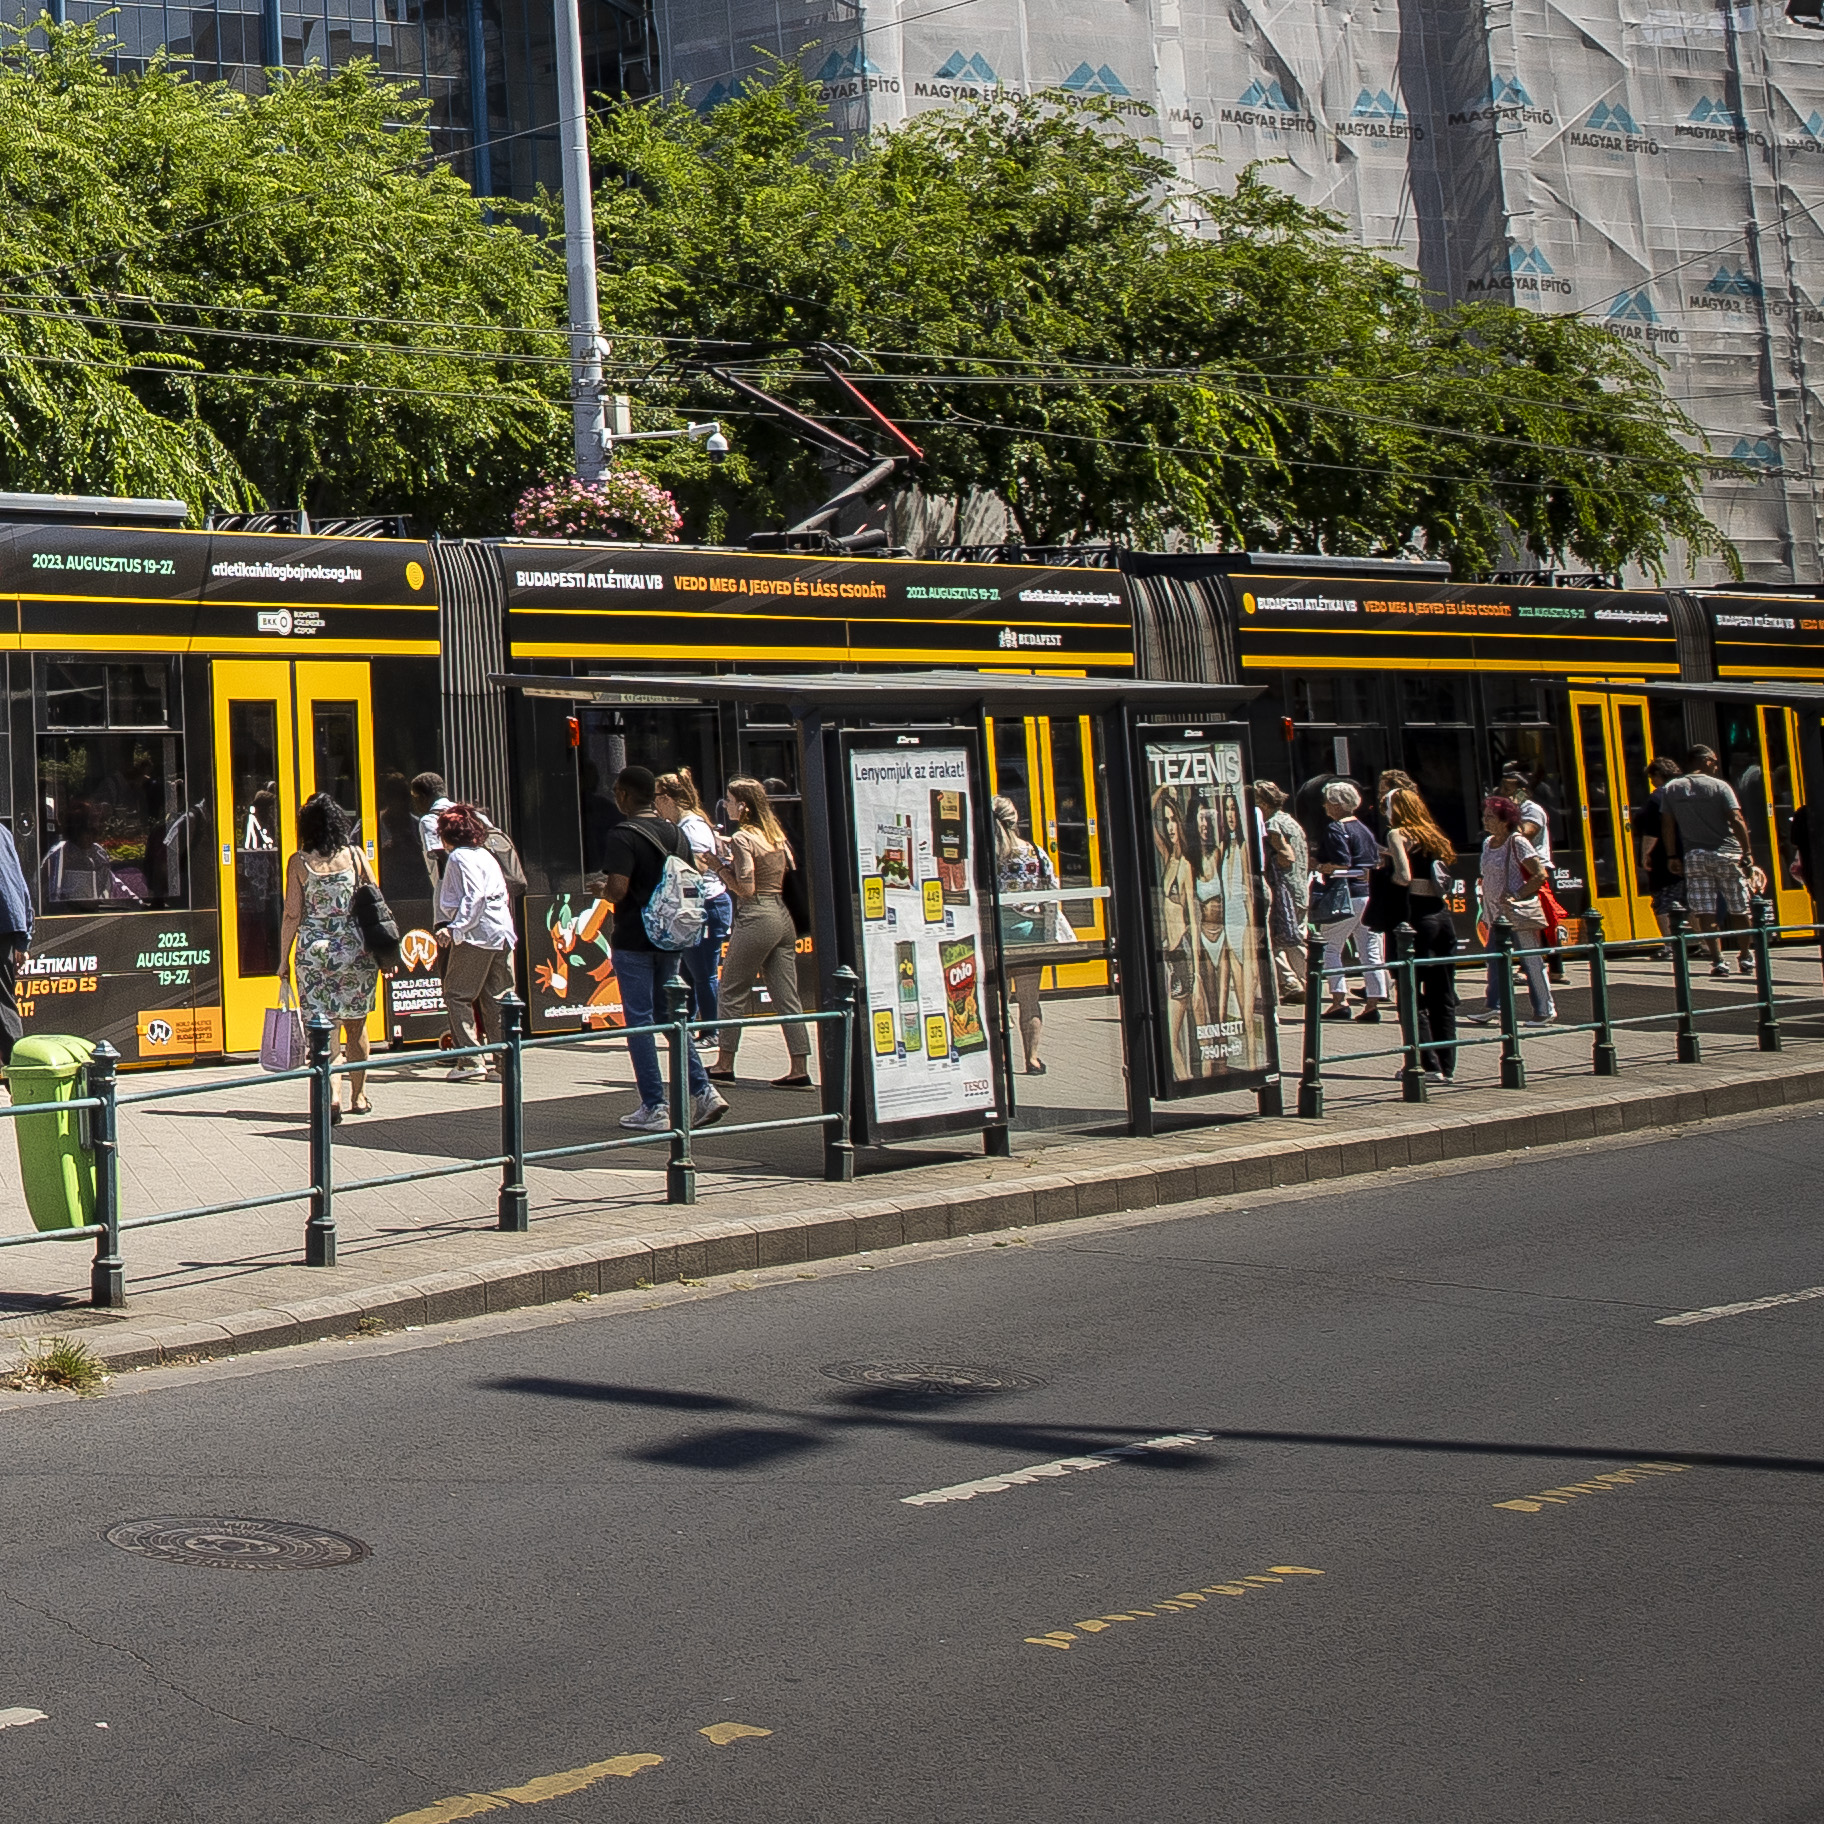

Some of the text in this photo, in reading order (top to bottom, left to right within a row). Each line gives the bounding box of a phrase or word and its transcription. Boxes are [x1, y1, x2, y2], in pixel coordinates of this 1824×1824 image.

[861, 75, 901, 93] ÉPÍTŐ
[914, 82, 978, 101] MAGYAR
[1220, 108, 1317, 133] MAGYAR ÉPÍTŐ
[1447, 102, 1554, 125] MAGYAR ÉPÍTŐ
[1334, 121, 1425, 141] MAGYAR ÉPÍTŐ
[1674, 123, 1723, 141] MAGYAR
[1570, 132, 1660, 156] MAGYAR ÉPÍTŐ
[1467, 273, 1572, 295] MAGYAR ÉPÍTŐ
[1689, 295, 1741, 313] MAGYAR
[1646, 319, 1680, 344] ÉPÍTŐ
[32, 553, 65, 569] 2023.
[66, 555, 141, 574] AUGUSZTUS
[211, 562, 363, 583] atletikaivilagbajnoksag.hu
[516, 568, 664, 590] BUDAPESTI ATLÉTIKAI VB
[674, 575, 887, 599] VEDD MEG A JEGYED ÉS LÁSS CSODÁT!
[928, 587, 979, 600] AUGUSZTUS
[262, 617, 278, 627] BKK
[1018, 632, 1062, 646] BUDAPEST
[854, 760, 965, 785] Lenyomjuk az árakat!
[1149, 750, 1241, 786] TEZENIS
[158, 932, 189, 948] 2023.
[79, 955, 98, 972] VB
[136, 949, 211, 969] AUGUSZTUS
[158, 970, 191, 986] 19-27.
[949, 961, 973, 986] Chio
[14, 980, 25, 996] A
[25, 977, 78, 998] JEGYED
[393, 999, 438, 1012] BUDAPEST
[963, 1079, 989, 1093] TESCO
